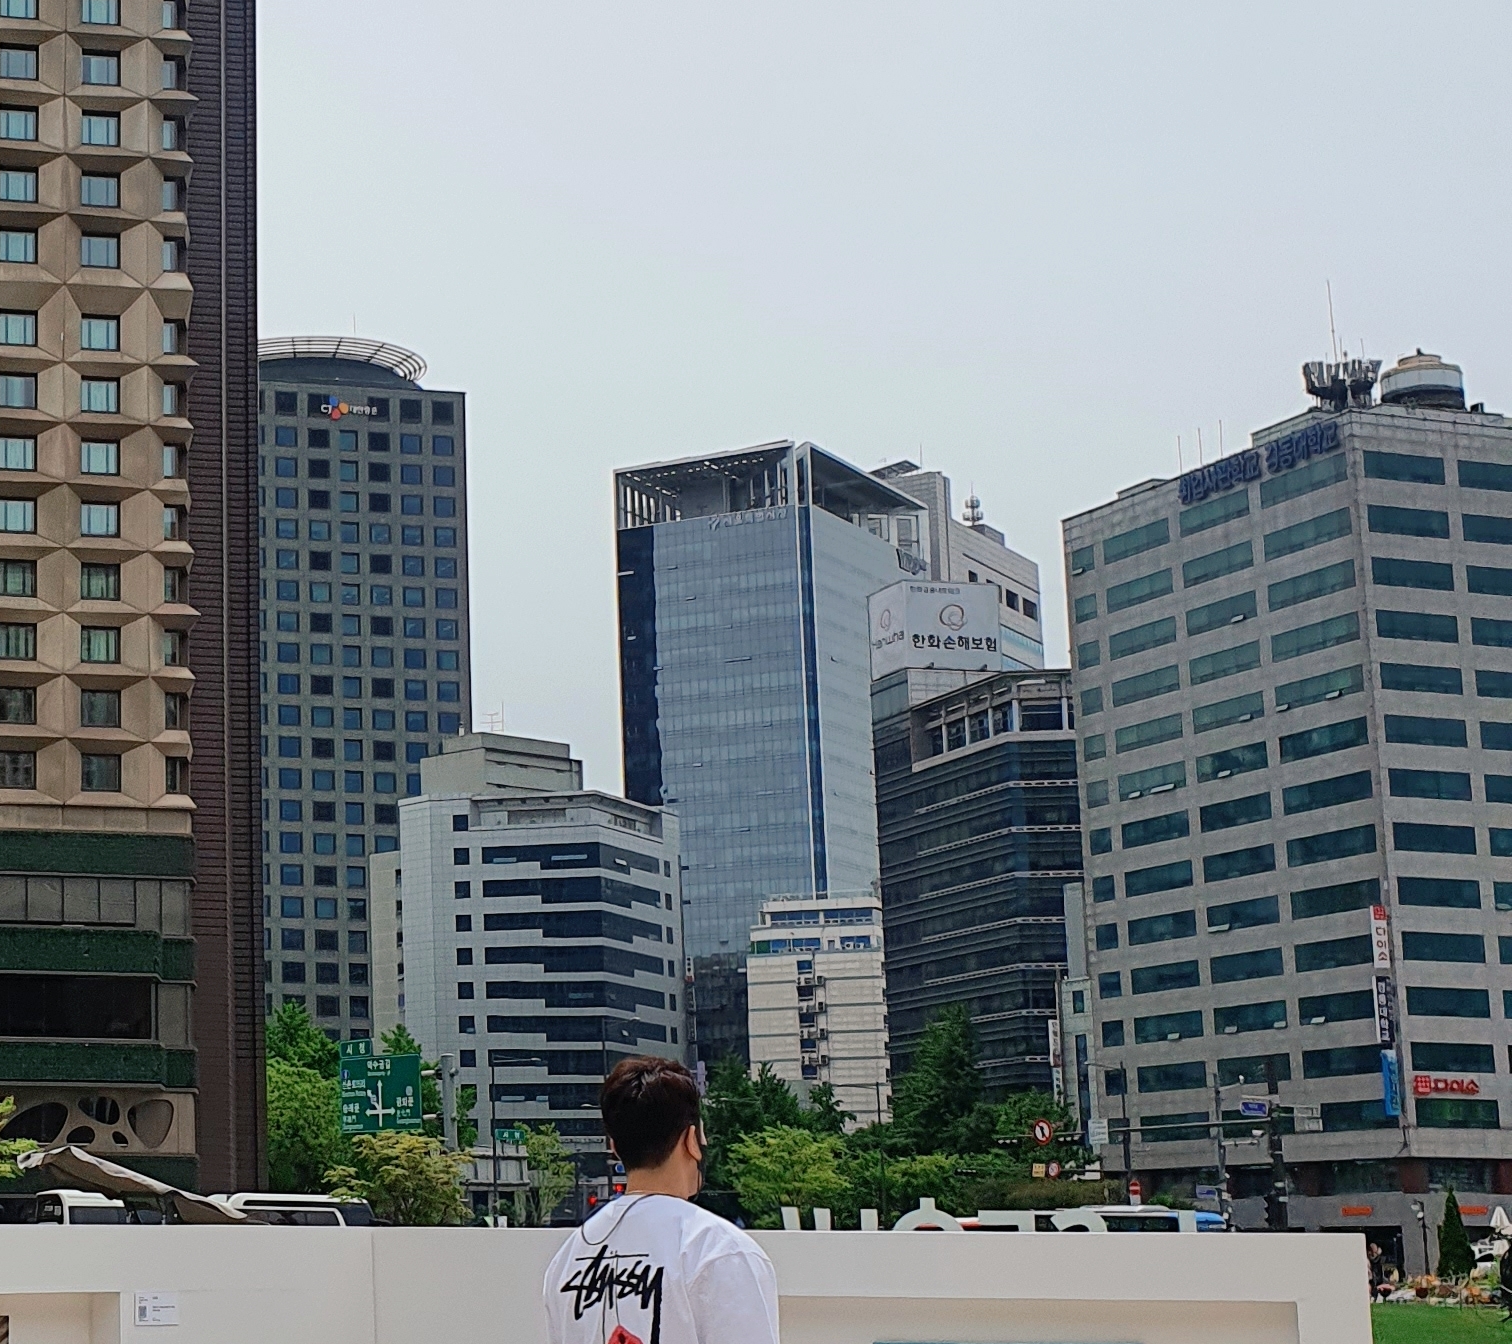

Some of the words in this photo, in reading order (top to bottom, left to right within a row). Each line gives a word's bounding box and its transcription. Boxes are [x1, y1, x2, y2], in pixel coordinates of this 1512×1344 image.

[912, 633, 997, 652] 한화손해보험
[1375, 926, 1388, 961] 다이소
[1432, 1078, 1479, 1095] 다이소
